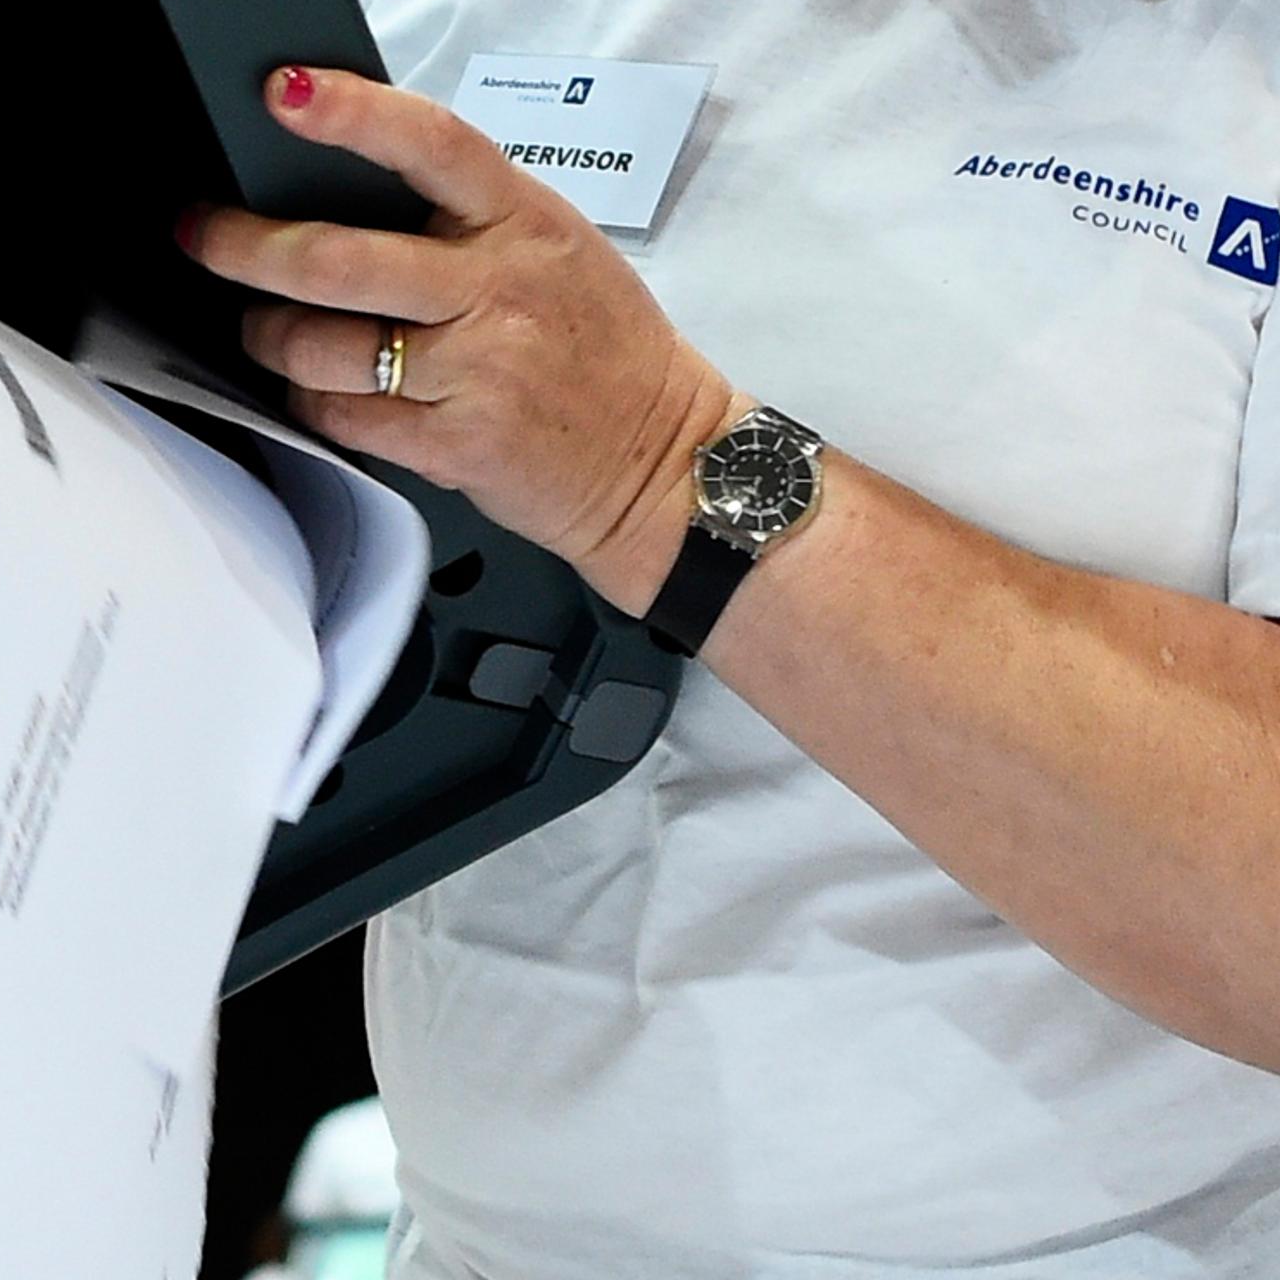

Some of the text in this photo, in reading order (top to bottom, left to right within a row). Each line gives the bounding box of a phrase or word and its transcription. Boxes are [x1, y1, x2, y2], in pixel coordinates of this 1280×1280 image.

[481, 76, 562, 91] Aberdeenshire
[496, 142, 634, 173] PERVISOR
[954, 154, 1201, 222] Aberdeenshire
[1071, 204, 1189, 254] COUNCIL
